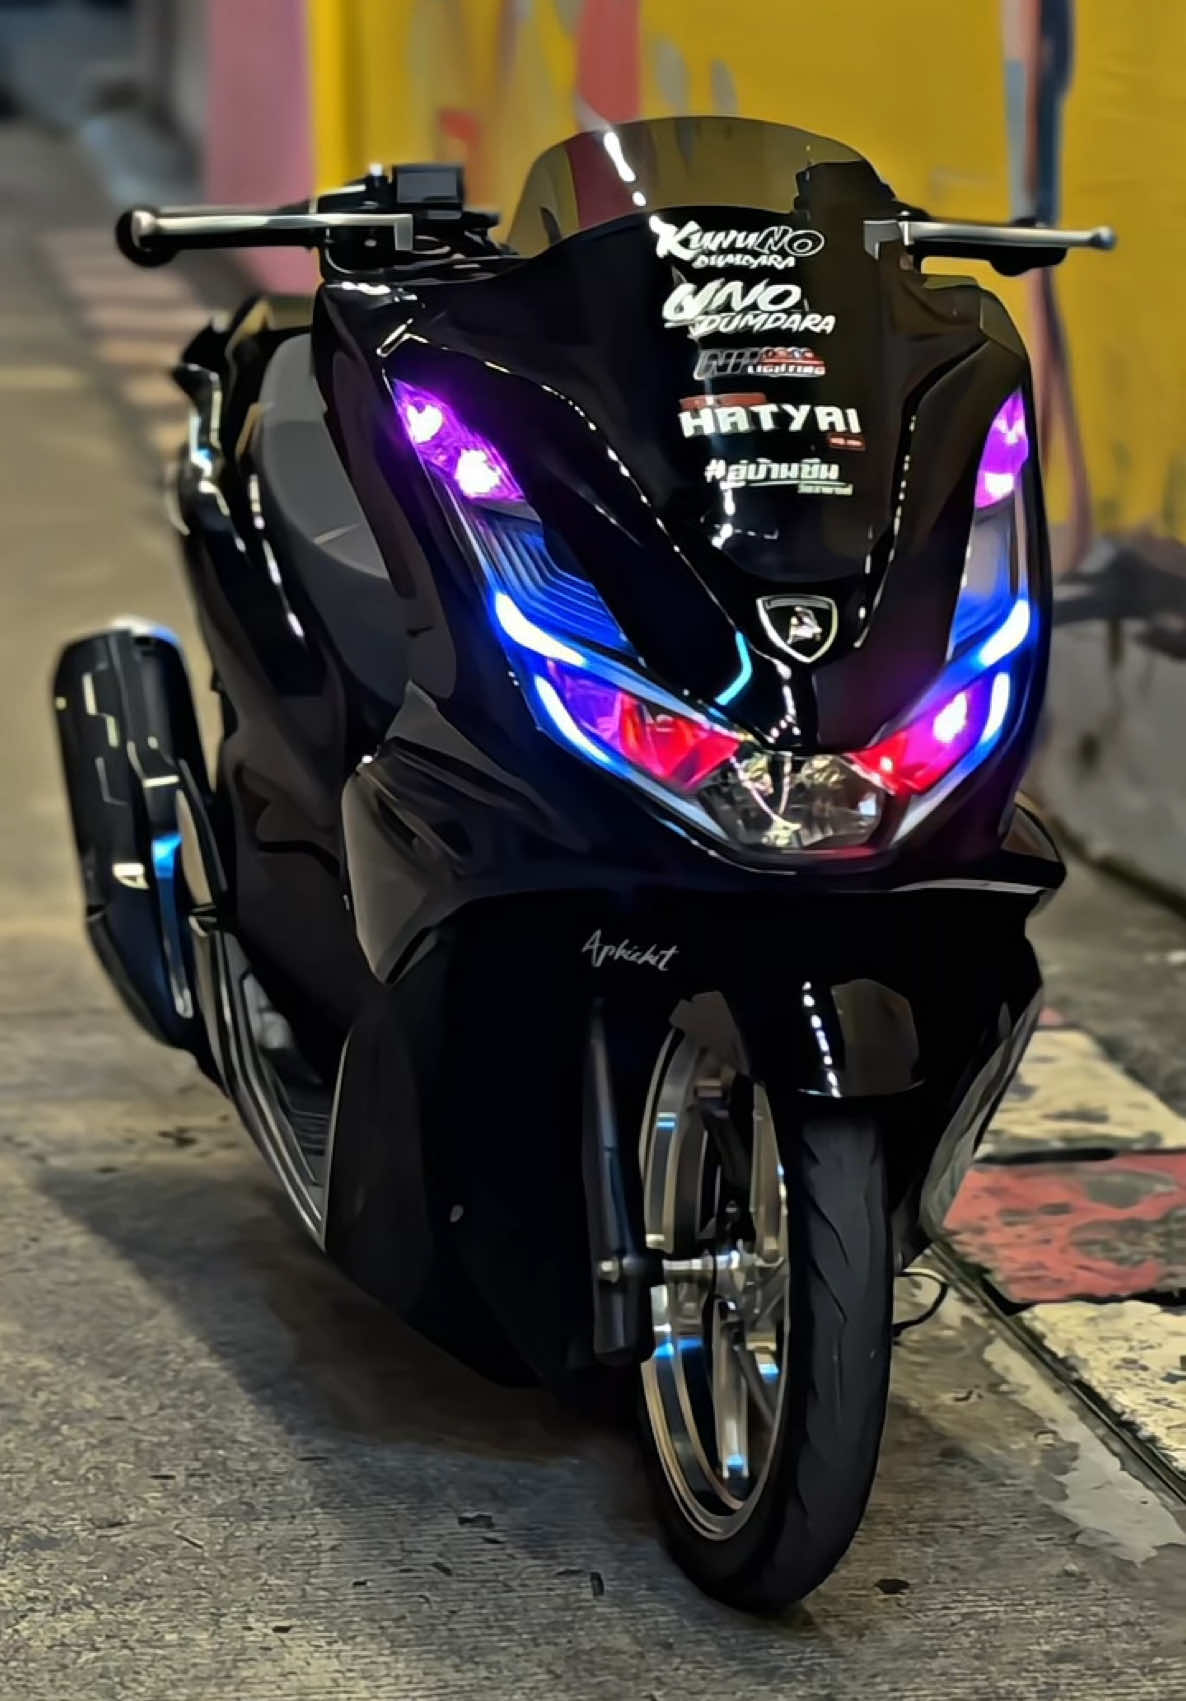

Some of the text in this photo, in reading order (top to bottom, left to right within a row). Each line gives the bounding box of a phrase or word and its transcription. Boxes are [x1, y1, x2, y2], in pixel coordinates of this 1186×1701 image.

[662, 278, 802, 321] UNO
[690, 311, 836, 339] DUMDARA
[678, 403, 862, 439] HATYAI
